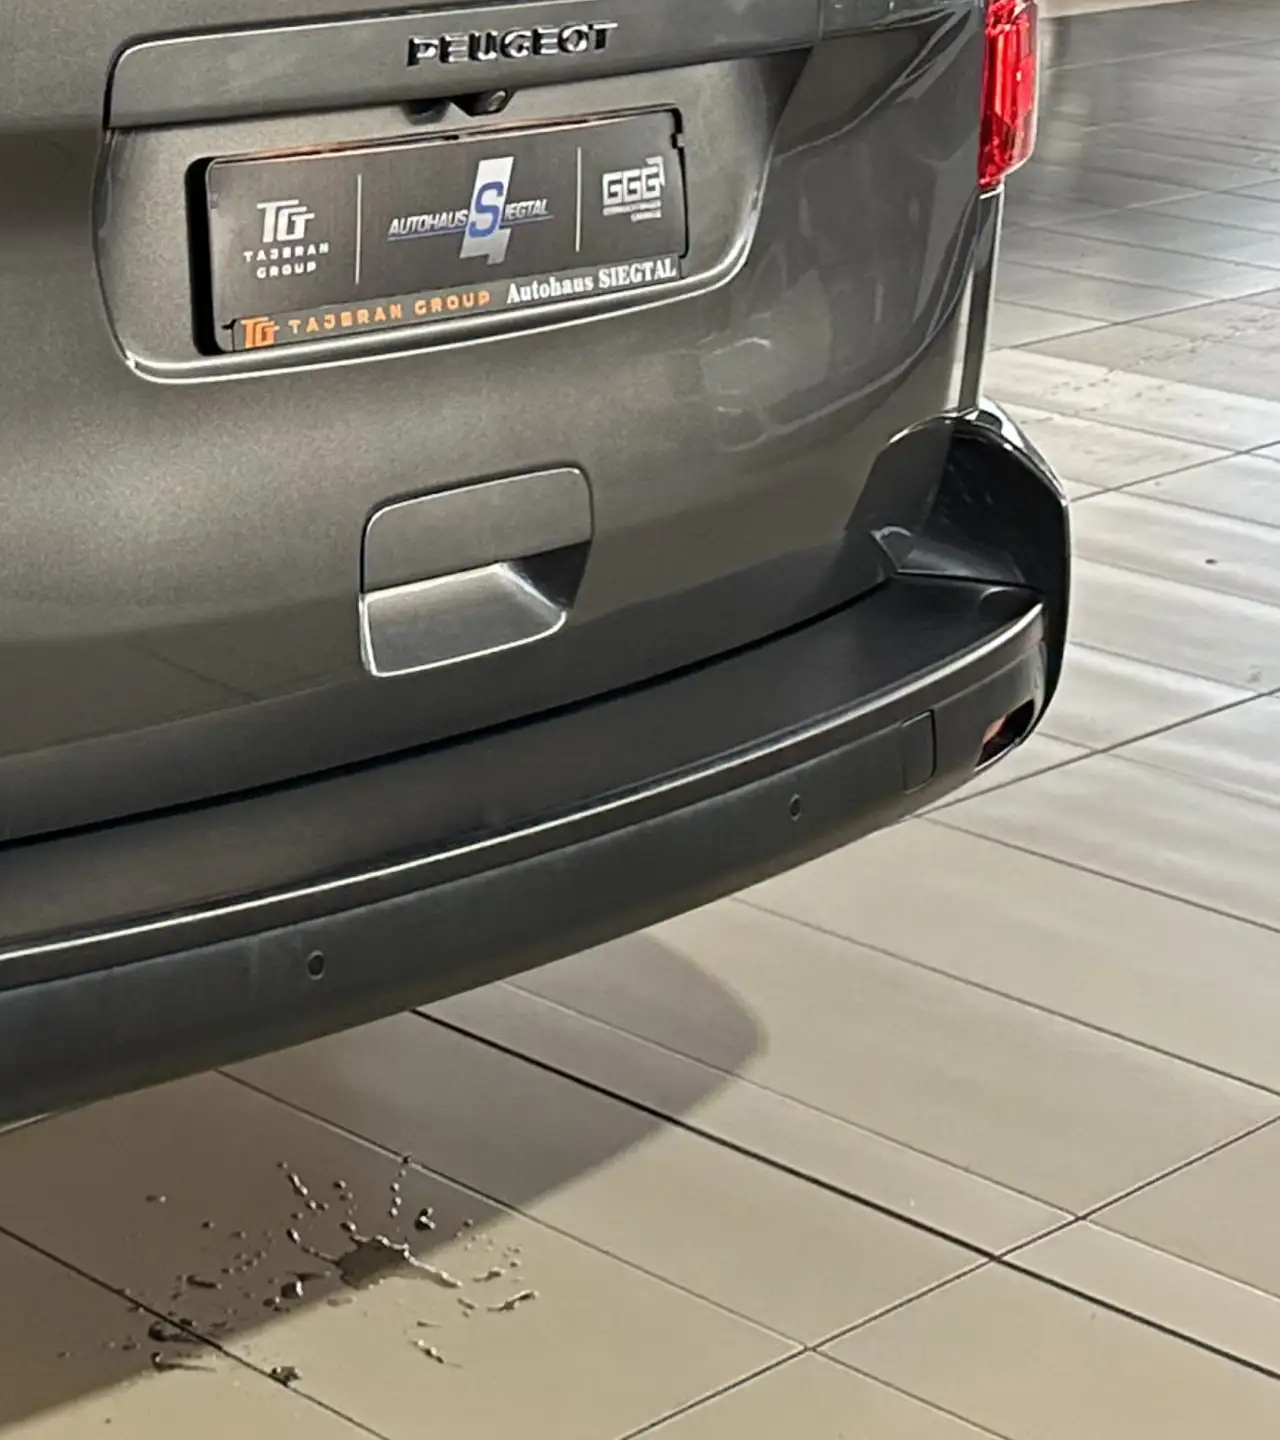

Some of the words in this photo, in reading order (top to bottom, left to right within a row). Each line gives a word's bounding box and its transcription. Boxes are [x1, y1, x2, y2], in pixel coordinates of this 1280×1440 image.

[407, 21, 619, 67] PEUGEOT
[388, 209, 469, 236] AUTOHAUS
[256, 261, 317, 279] GROUP
[288, 303, 403, 335] TAJERAN
[414, 290, 491, 317] GROUP
[506, 276, 594, 305] Autohaus
[598, 258, 677, 289] SIEGTAL
